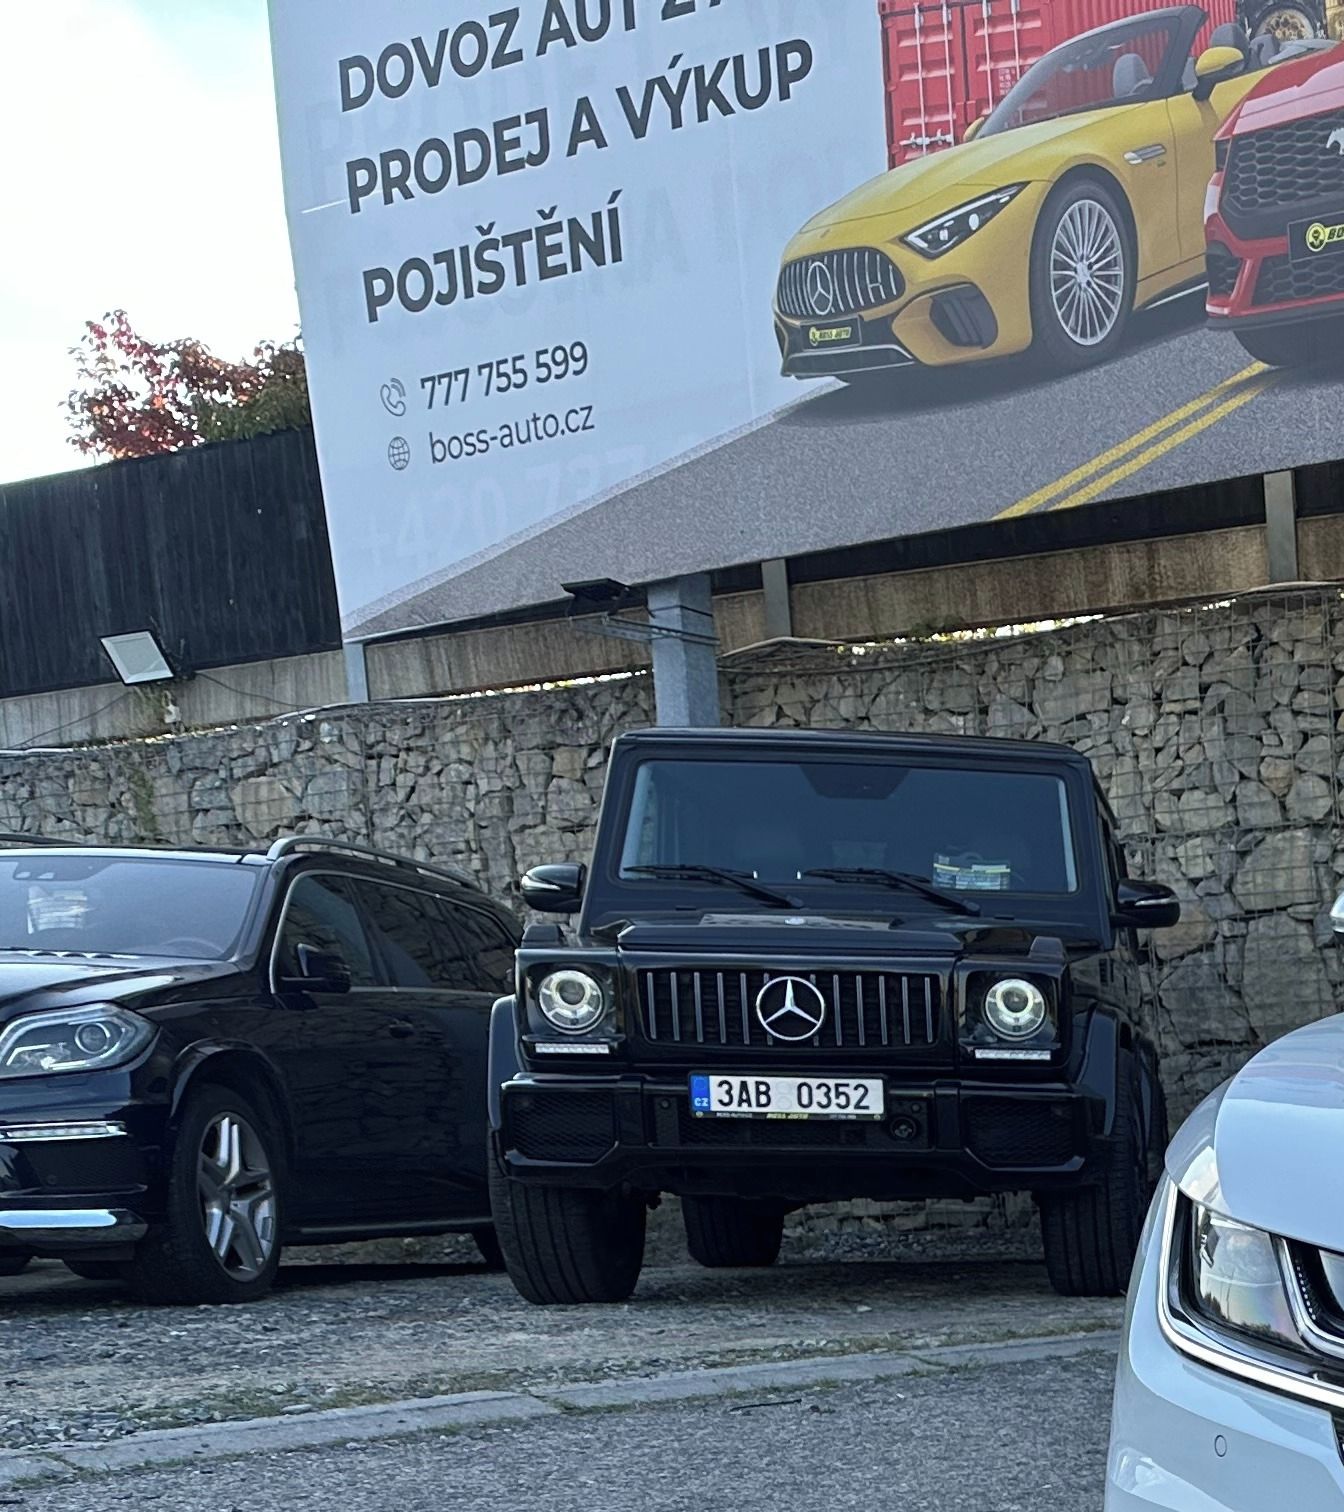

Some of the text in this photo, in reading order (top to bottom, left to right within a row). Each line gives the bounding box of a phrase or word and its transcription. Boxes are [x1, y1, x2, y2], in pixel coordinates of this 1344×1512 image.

[338, 6, 524, 112] DOVOZ
[345, 38, 814, 215] PRODEJ A VÝKUP
[361, 188, 624, 324] POJIŠTĚNÍ
[419, 340, 589, 410] 777 755 599
[428, 404, 596, 464] boss-auto.cz
[694, 1097, 709, 1107] CZ
[716, 1079, 870, 1111] 3AB 0352
